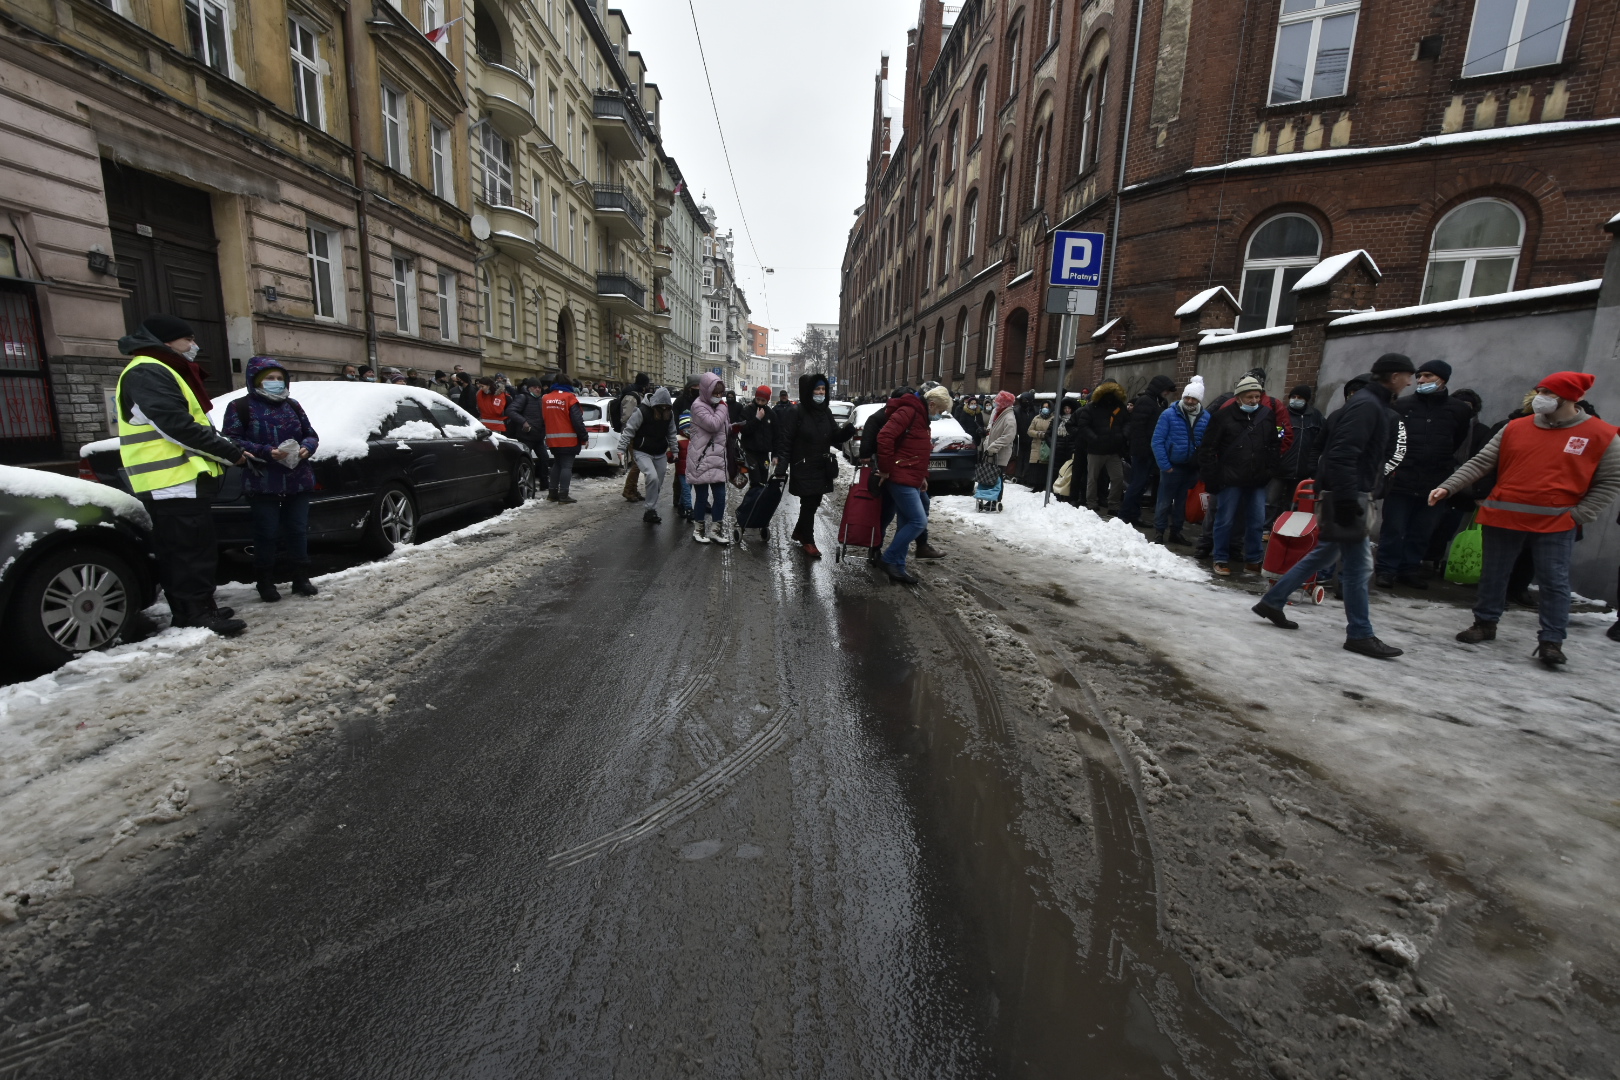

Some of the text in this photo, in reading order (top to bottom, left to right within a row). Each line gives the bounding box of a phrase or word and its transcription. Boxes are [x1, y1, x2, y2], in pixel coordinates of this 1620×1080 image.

[1061, 237, 1092, 279] P
[1069, 272, 1092, 282] Płatny
[1397, 420, 1407, 443] COAST
[1392, 443, 1407, 461] WEST
